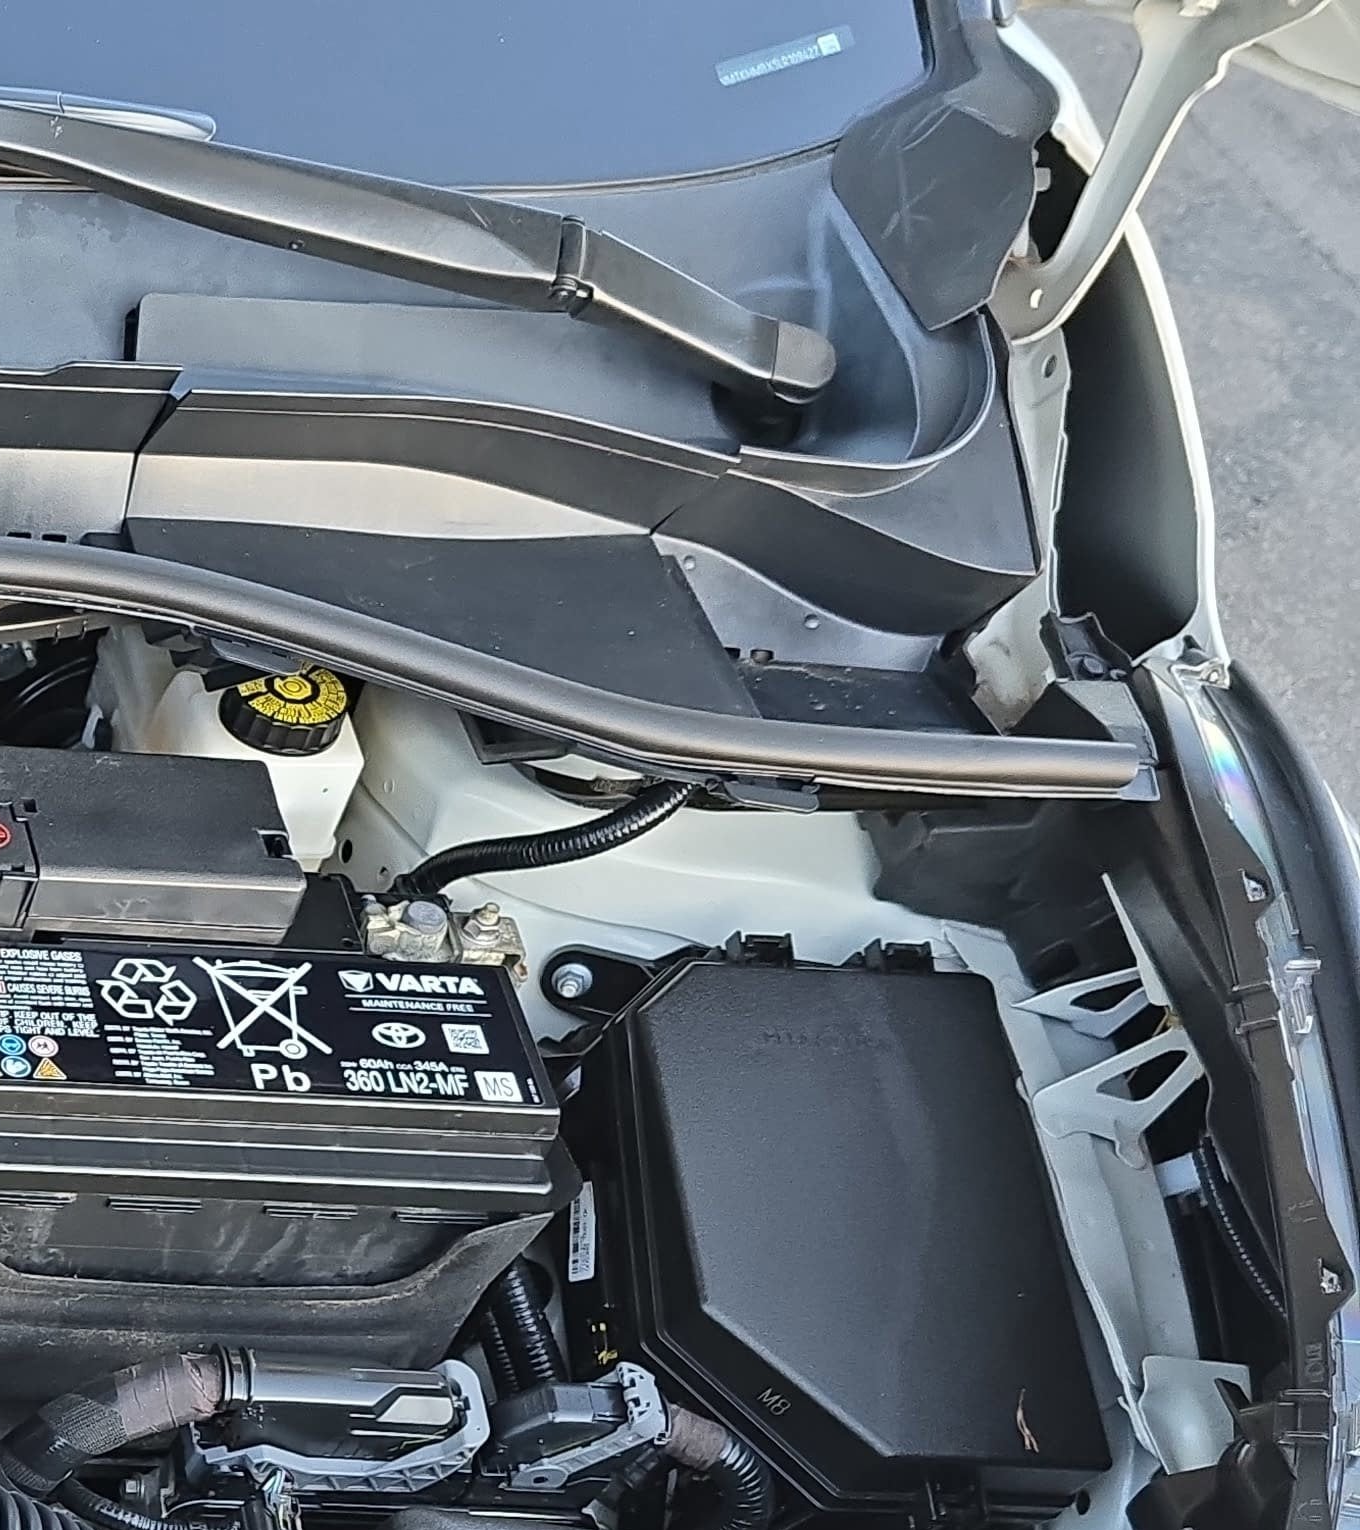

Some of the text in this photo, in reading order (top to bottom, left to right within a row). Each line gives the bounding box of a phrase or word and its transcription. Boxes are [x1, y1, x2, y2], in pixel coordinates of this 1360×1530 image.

[375, 972, 485, 996] VARTA
[362, 999, 475, 1012] MAINTENANCE FREE
[14, 1010, 39, 1019] KEEP
[40, 1012, 60, 1020] OUT
[62, 1013, 75, 1021] OF
[77, 1014, 97, 1022] THE
[14, 1025, 41, 1035] TIGHT
[44, 1026, 66, 1036] AND
[72, 1020, 98, 1030] KEEP
[359, 1058, 394, 1070] 60Ah
[413, 1060, 449, 1072] 345A
[251, 1063, 311, 1092] Pb
[344, 1069, 469, 1096] 360 LN2-MF
[482, 1076, 514, 1097] MS
[757, 1388, 791, 1415] M8
